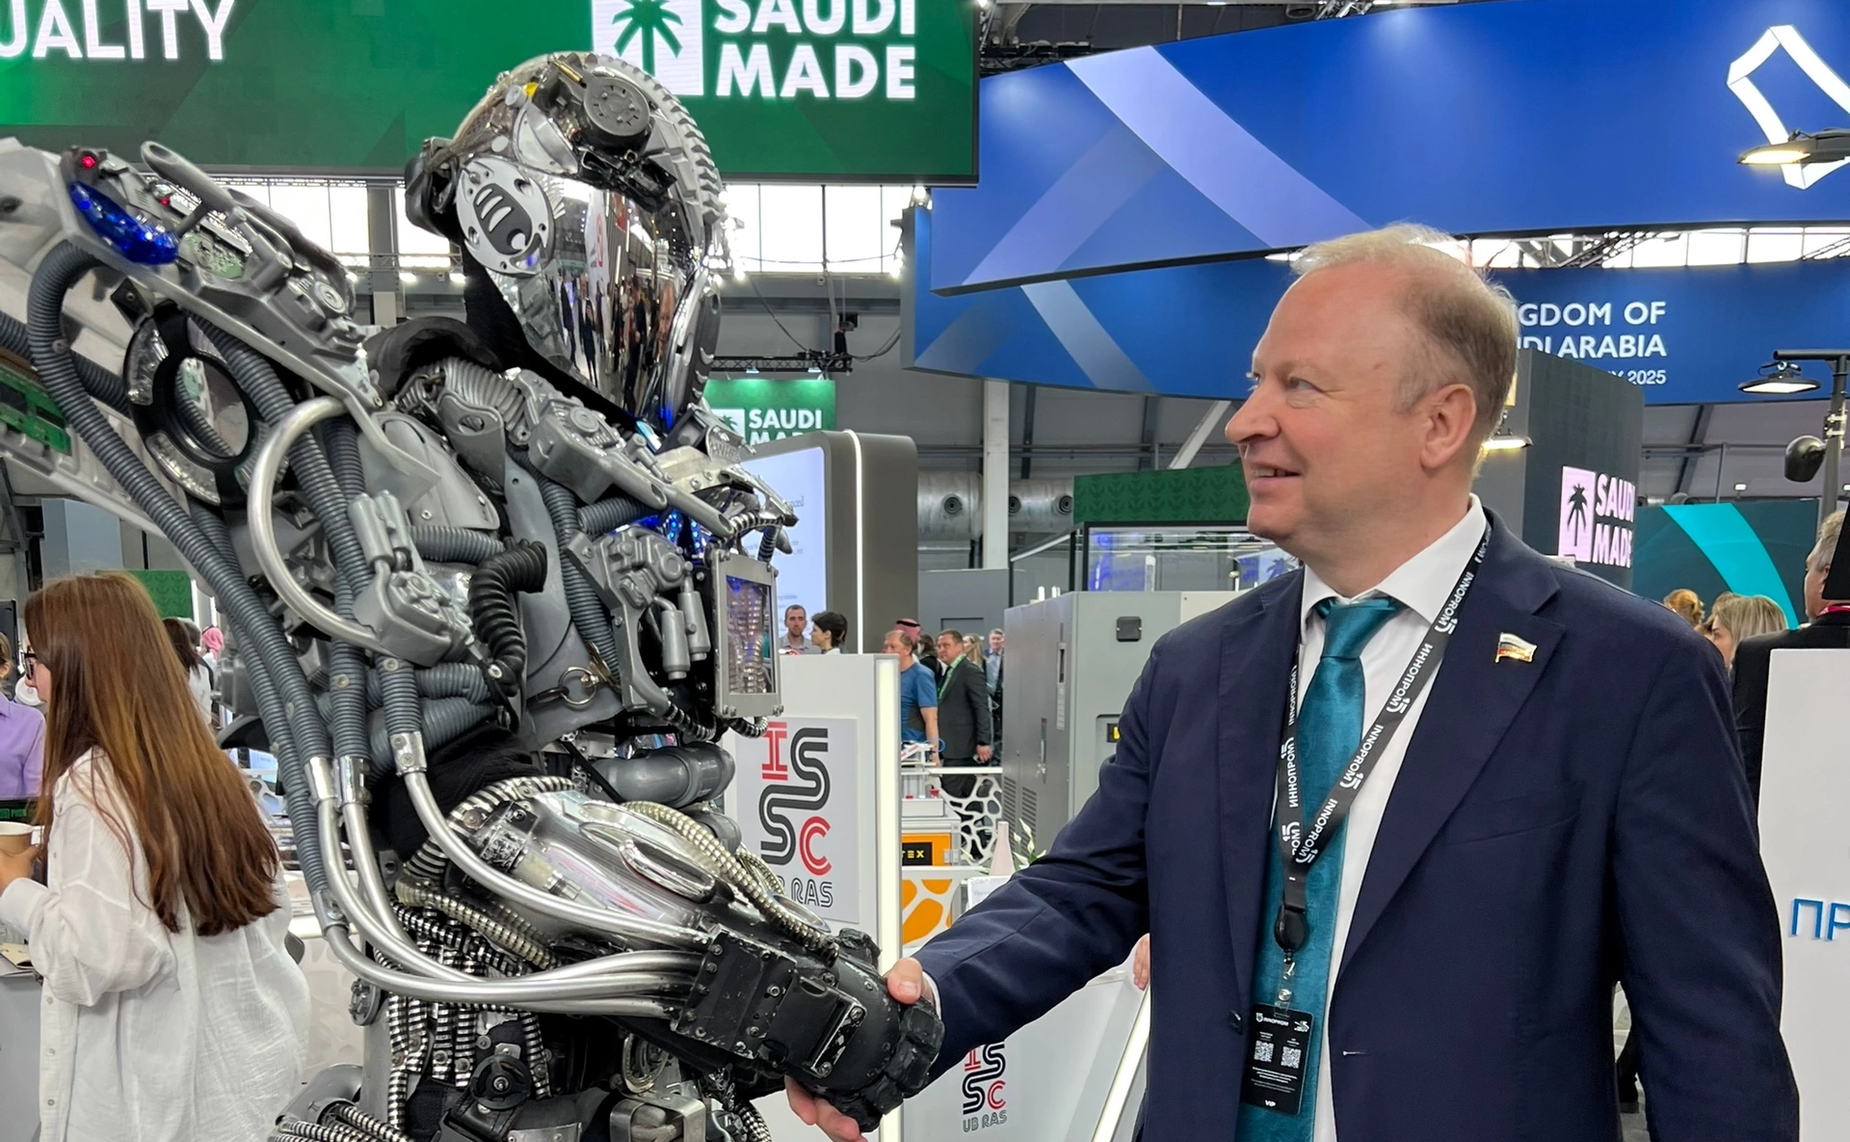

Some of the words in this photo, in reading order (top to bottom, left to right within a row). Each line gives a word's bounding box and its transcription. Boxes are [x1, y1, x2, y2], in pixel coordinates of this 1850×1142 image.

[714, 0, 916, 35] SAUDI
[715, 44, 916, 99] MADE
[1624, 301, 1666, 325] OF
[1558, 334, 1667, 358] ARABIA
[1628, 370, 1667, 385] 2025
[748, 408, 822, 430] SAUDI
[1595, 473, 1636, 523] SAUDI
[1436, 571, 1475, 627] INNOPROM
[1288, 672, 1298, 726] INNOPROM
[1390, 643, 1433, 709] ИННОПРОМ
[1287, 743, 1300, 808] ИННОПРОМ
[1341, 724, 1384, 784] INNOPROM
[1299, 798, 1339, 858] INNOPROM
[791, 877, 834, 908] RAS
[962, 1116, 979, 1133] UB
[981, 1109, 1008, 1129] RAS
